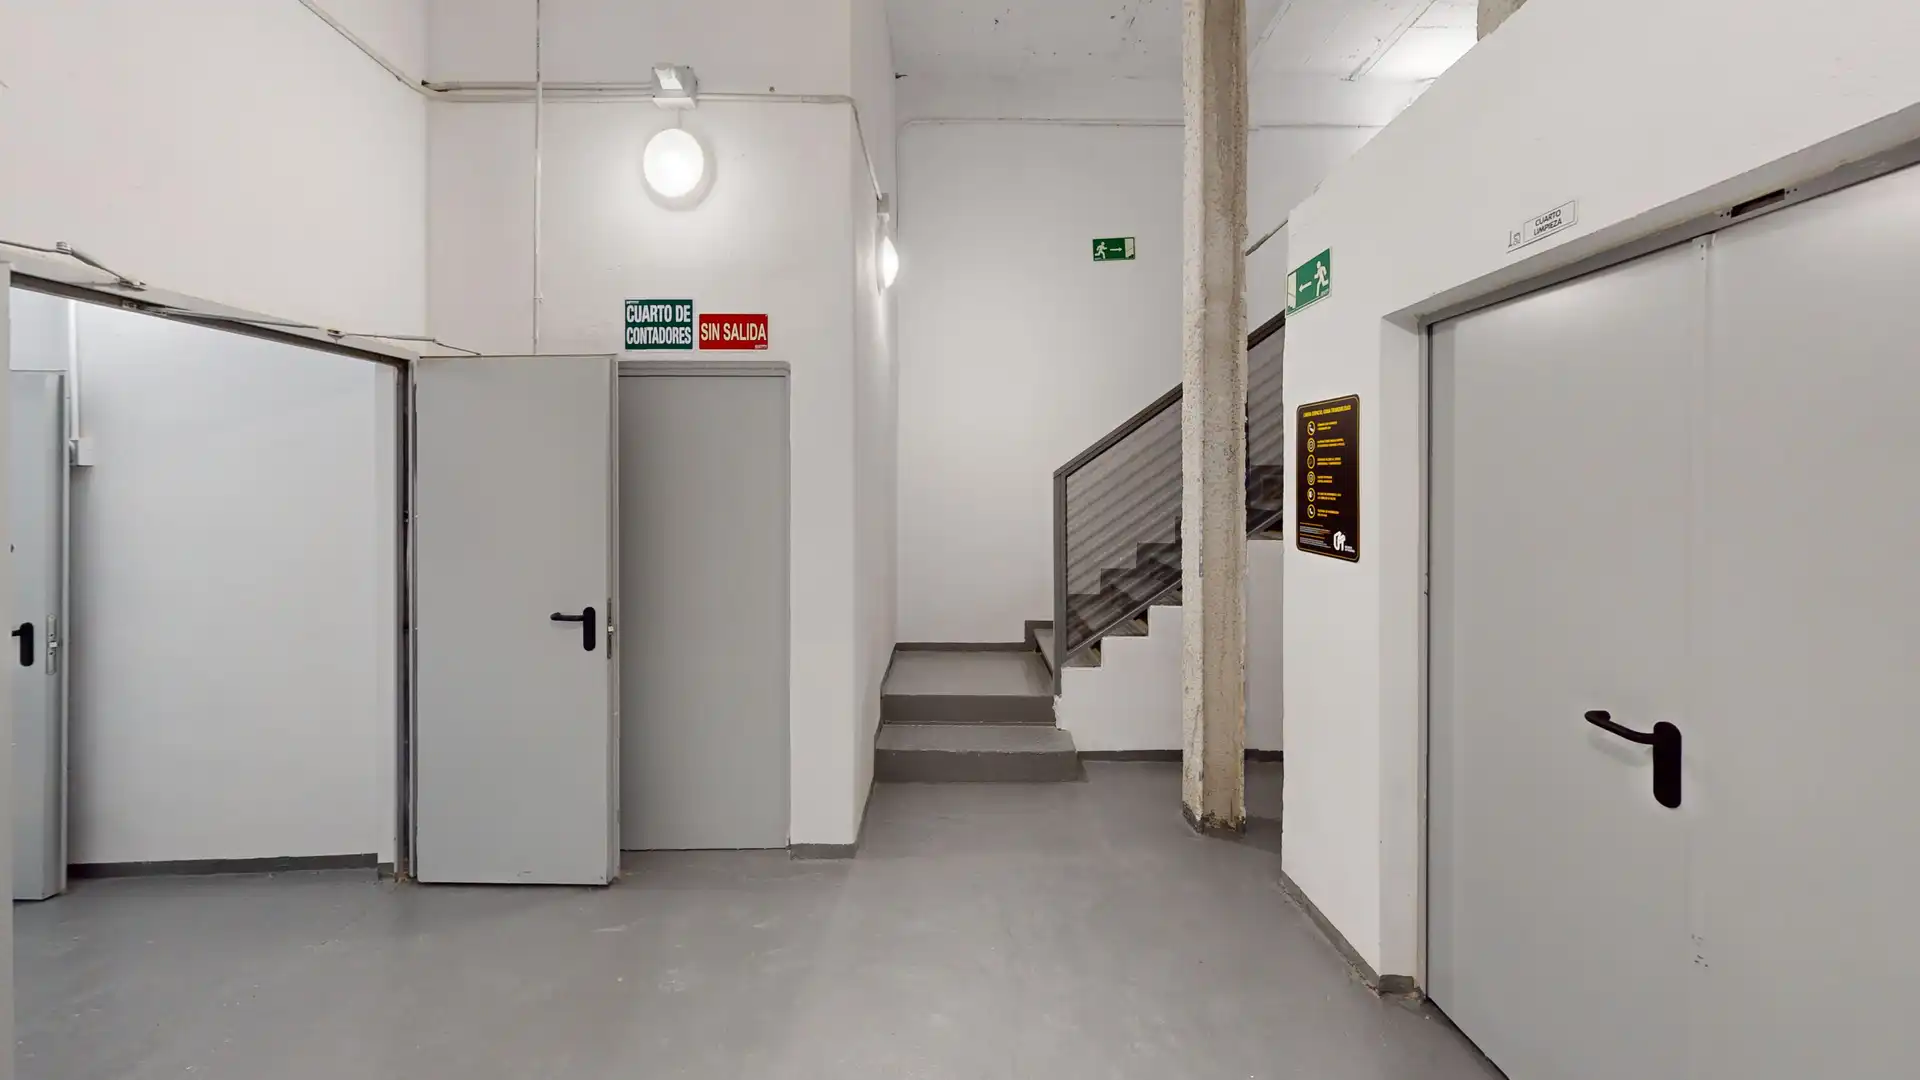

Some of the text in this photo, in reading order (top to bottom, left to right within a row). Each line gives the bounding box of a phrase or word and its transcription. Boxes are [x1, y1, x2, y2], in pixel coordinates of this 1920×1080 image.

[1533, 218, 1562, 235] LIMPIEZA
[1535, 209, 1561, 227] CUARTO
[626, 304, 691, 323] CUARTO DE
[626, 326, 691, 345] CONTADORES
[700, 322, 767, 341] SIN SALIDA
